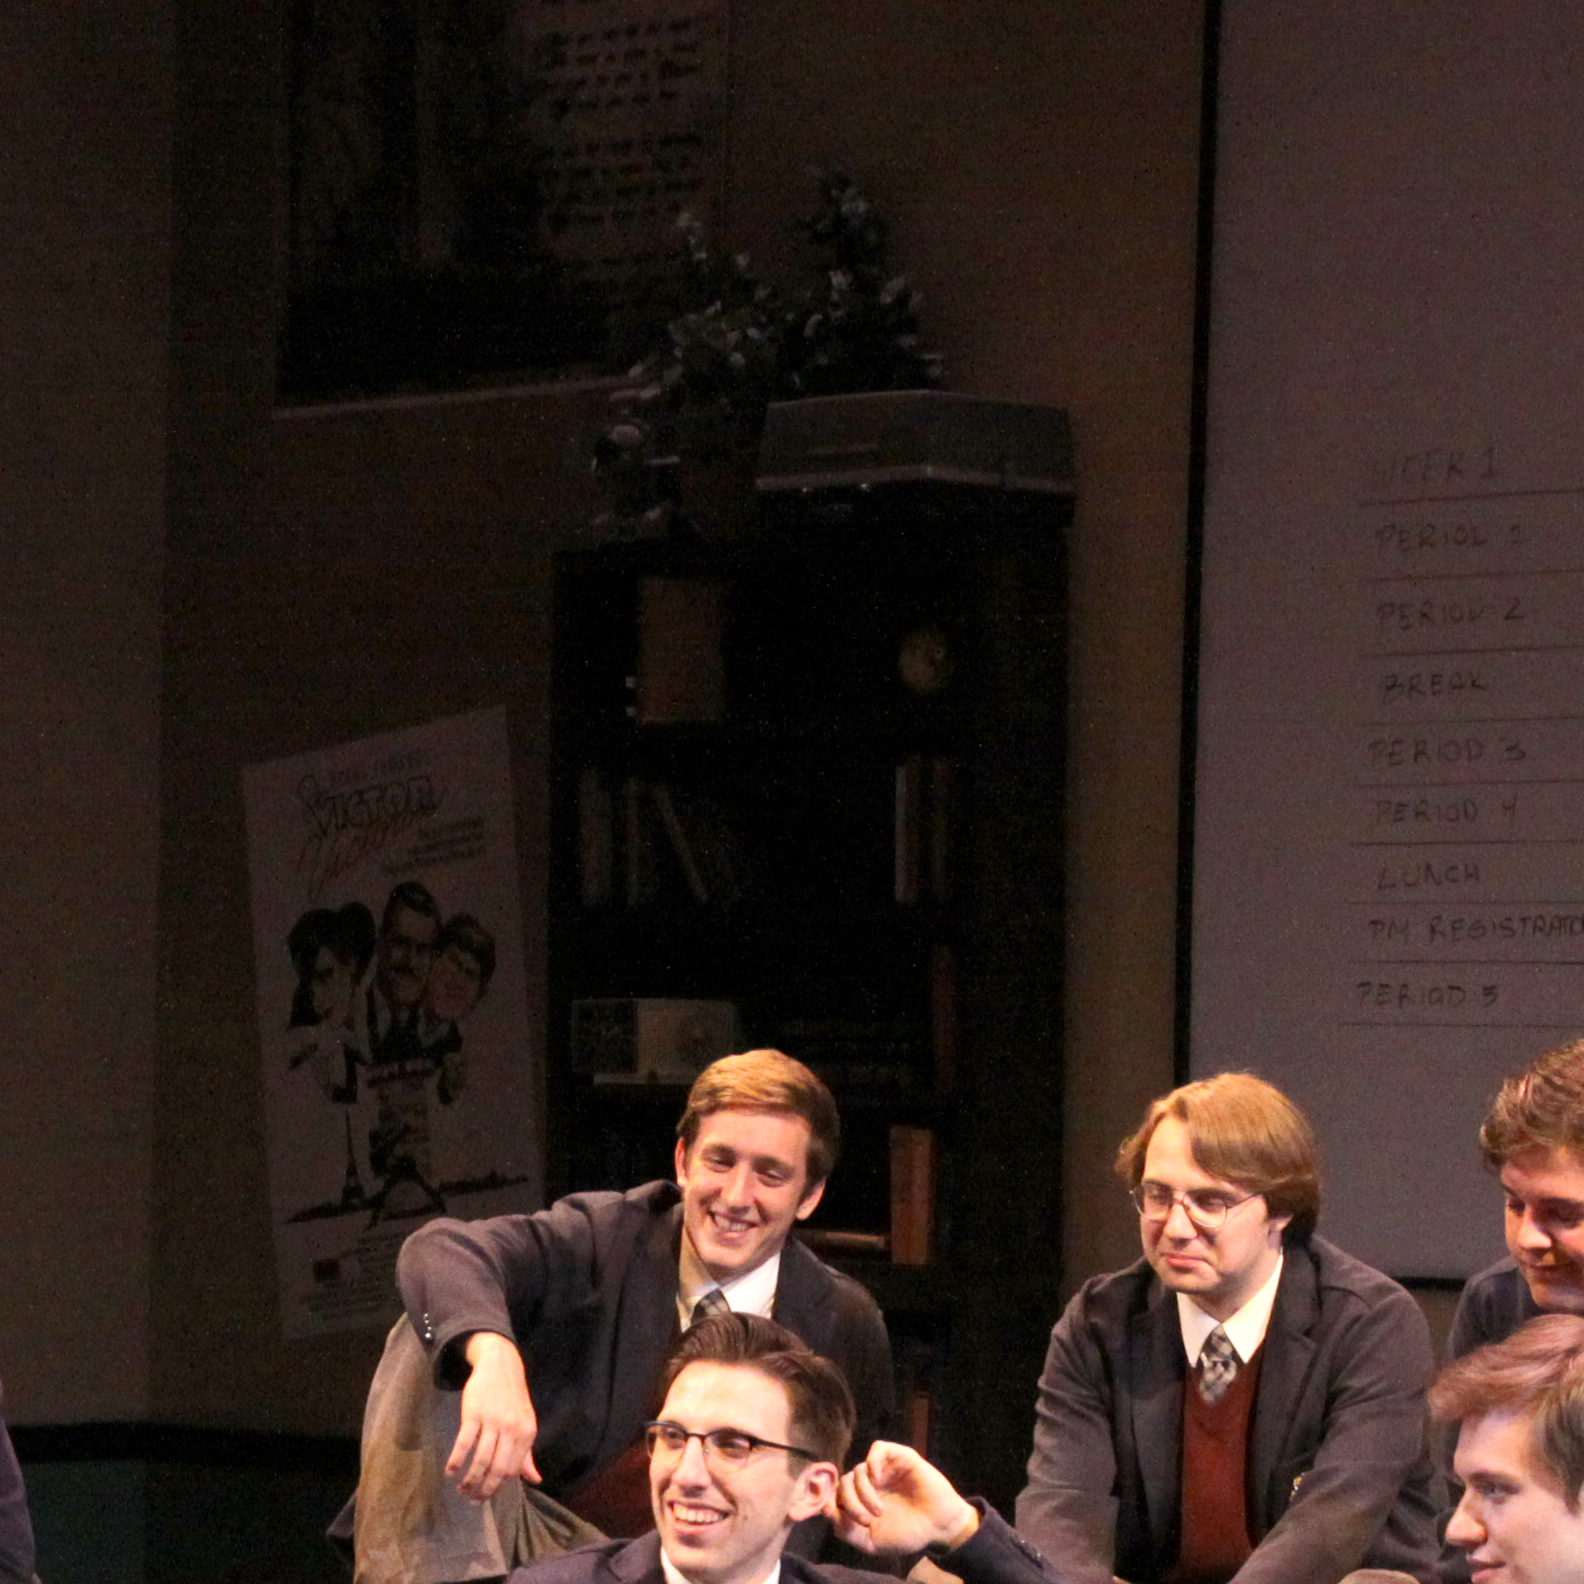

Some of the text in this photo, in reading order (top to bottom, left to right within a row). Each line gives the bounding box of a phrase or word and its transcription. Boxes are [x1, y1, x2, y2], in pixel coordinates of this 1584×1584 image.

[1502, 597, 1525, 622] 2
[1381, 672, 1489, 699] BREAK
[1366, 736, 1528, 768] PERIOD 3
[1375, 793, 1519, 829] PERIOD 4
[1376, 863, 1481, 892] LUNCH
[1368, 917, 1410, 944] PM
[1357, 980, 1499, 1008] PERIOD 5
